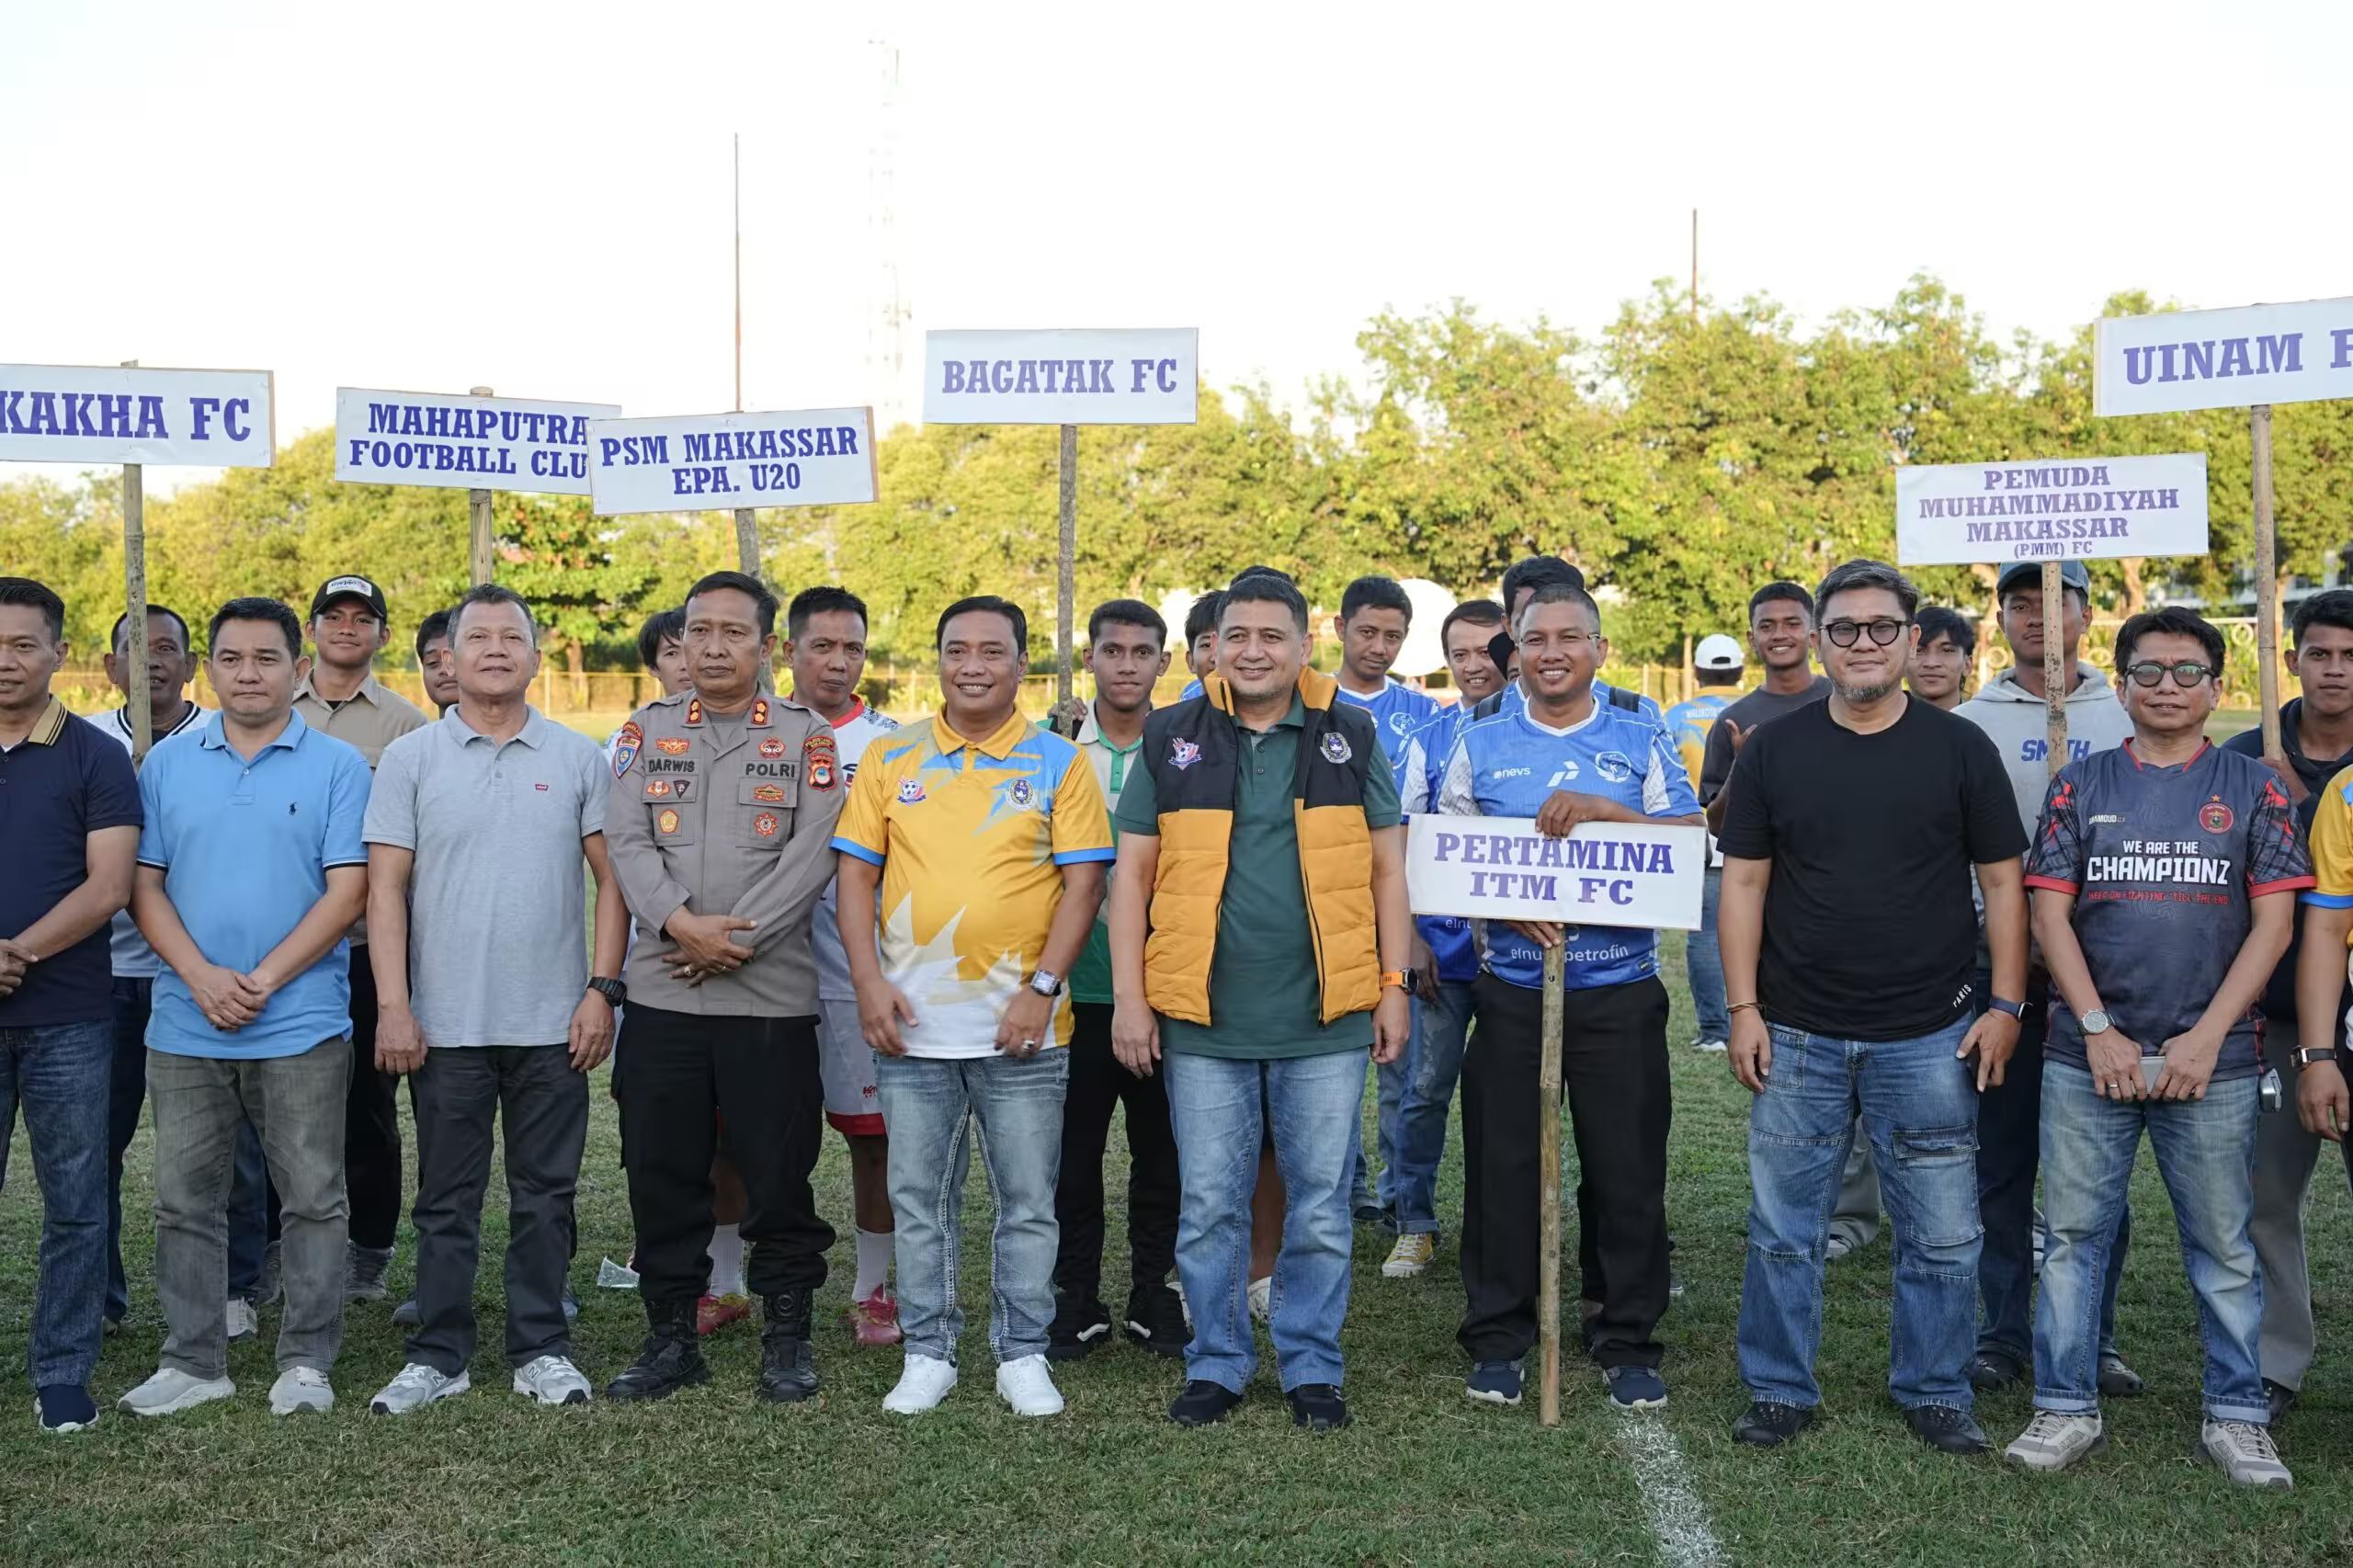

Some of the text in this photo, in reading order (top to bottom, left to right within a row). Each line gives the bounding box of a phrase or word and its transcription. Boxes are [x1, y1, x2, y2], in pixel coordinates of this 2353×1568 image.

[2123, 333, 2304, 386] UINAM
[941, 358, 1177, 394] BAGATAK FC
[0, 390, 251, 441] KAKHA FC
[369, 403, 588, 446] MAHAPUTRA
[349, 439, 588, 479] FOOTBALL CLU
[599, 426, 858, 468] PSM MAKASSAR
[672, 462, 801, 496] EPA. U20
[1984, 466, 2110, 491] PEMUDA
[1919, 489, 2179, 519] MUHAMMADIYAH
[1966, 517, 2129, 543] MAKASSAR
[2013, 540, 2093, 559] (PMM) FC
[2021, 739, 2091, 761] SMTH
[648, 758, 695, 773] DARWIS
[745, 763, 795, 778] POLRI
[1434, 832, 1675, 874] PERTAMINA
[2122, 840, 2199, 855] WE ARE THE
[2086, 856, 2231, 885] CHAMPIONZ
[1470, 871, 1633, 906] ITM FC
[1510, 948, 1543, 961] elnu
